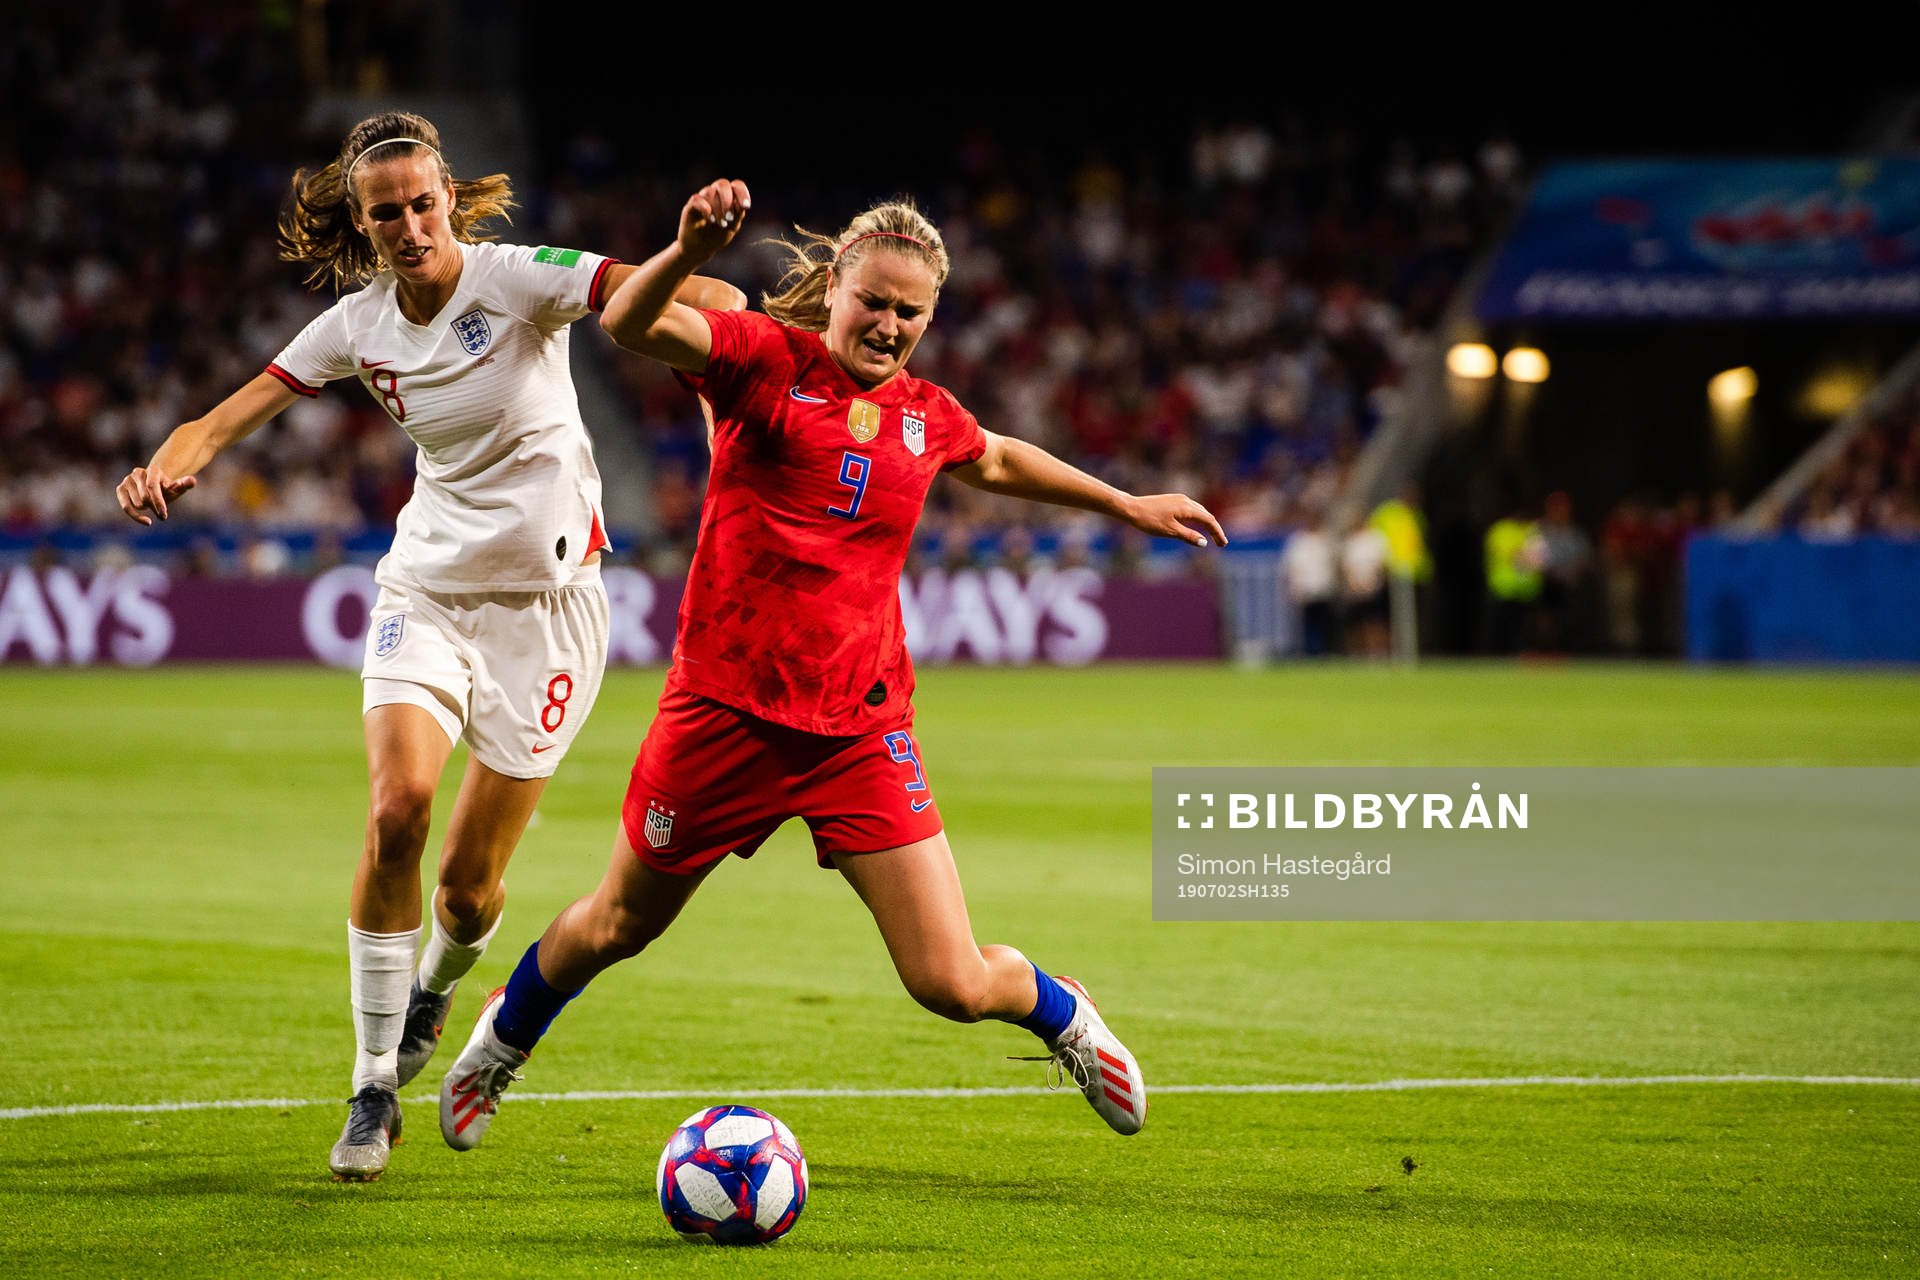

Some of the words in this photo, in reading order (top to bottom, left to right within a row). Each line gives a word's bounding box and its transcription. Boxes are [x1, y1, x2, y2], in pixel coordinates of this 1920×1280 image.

[371, 369, 405, 422] 8
[904, 418, 923, 435] USA
[827, 451, 872, 520] 9
[541, 673, 573, 733] 8
[883, 730, 926, 791] 9
[649, 810, 671, 829] USA
